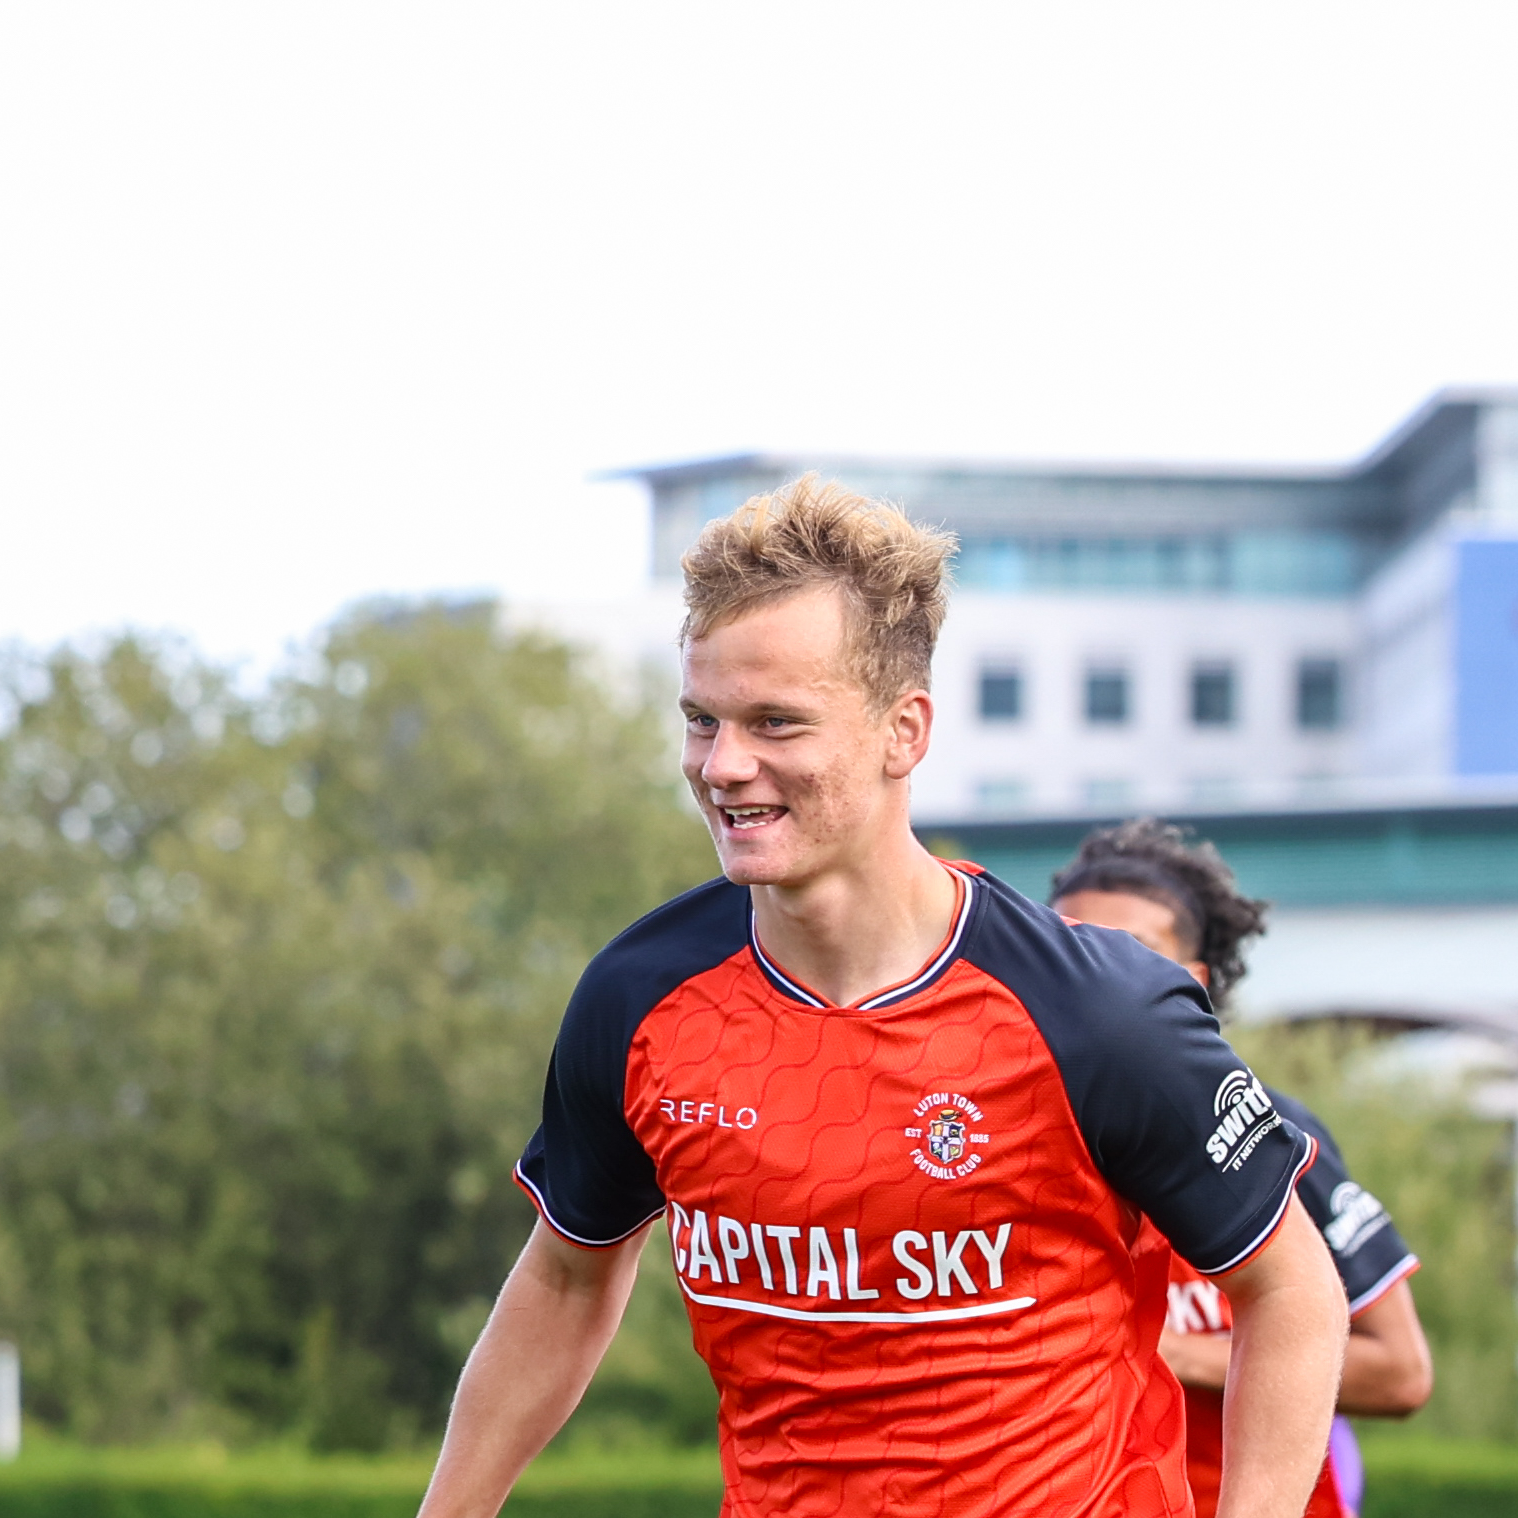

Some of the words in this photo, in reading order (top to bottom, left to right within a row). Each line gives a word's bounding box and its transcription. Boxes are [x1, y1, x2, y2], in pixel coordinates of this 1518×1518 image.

[659, 1098, 758, 1130] REFLO
[913, 1092, 949, 1117] LUTON
[952, 1093, 984, 1122] TOWN
[905, 1127, 922, 1138] EST
[969, 1133, 990, 1143] 1885
[909, 1148, 957, 1180] FOOTBALL
[955, 1153, 982, 1176] CLUB
[1232, 1157, 1243, 1171] IT
[670, 1200, 880, 1300] CAPITAL
[892, 1222, 1012, 1300] SKY
